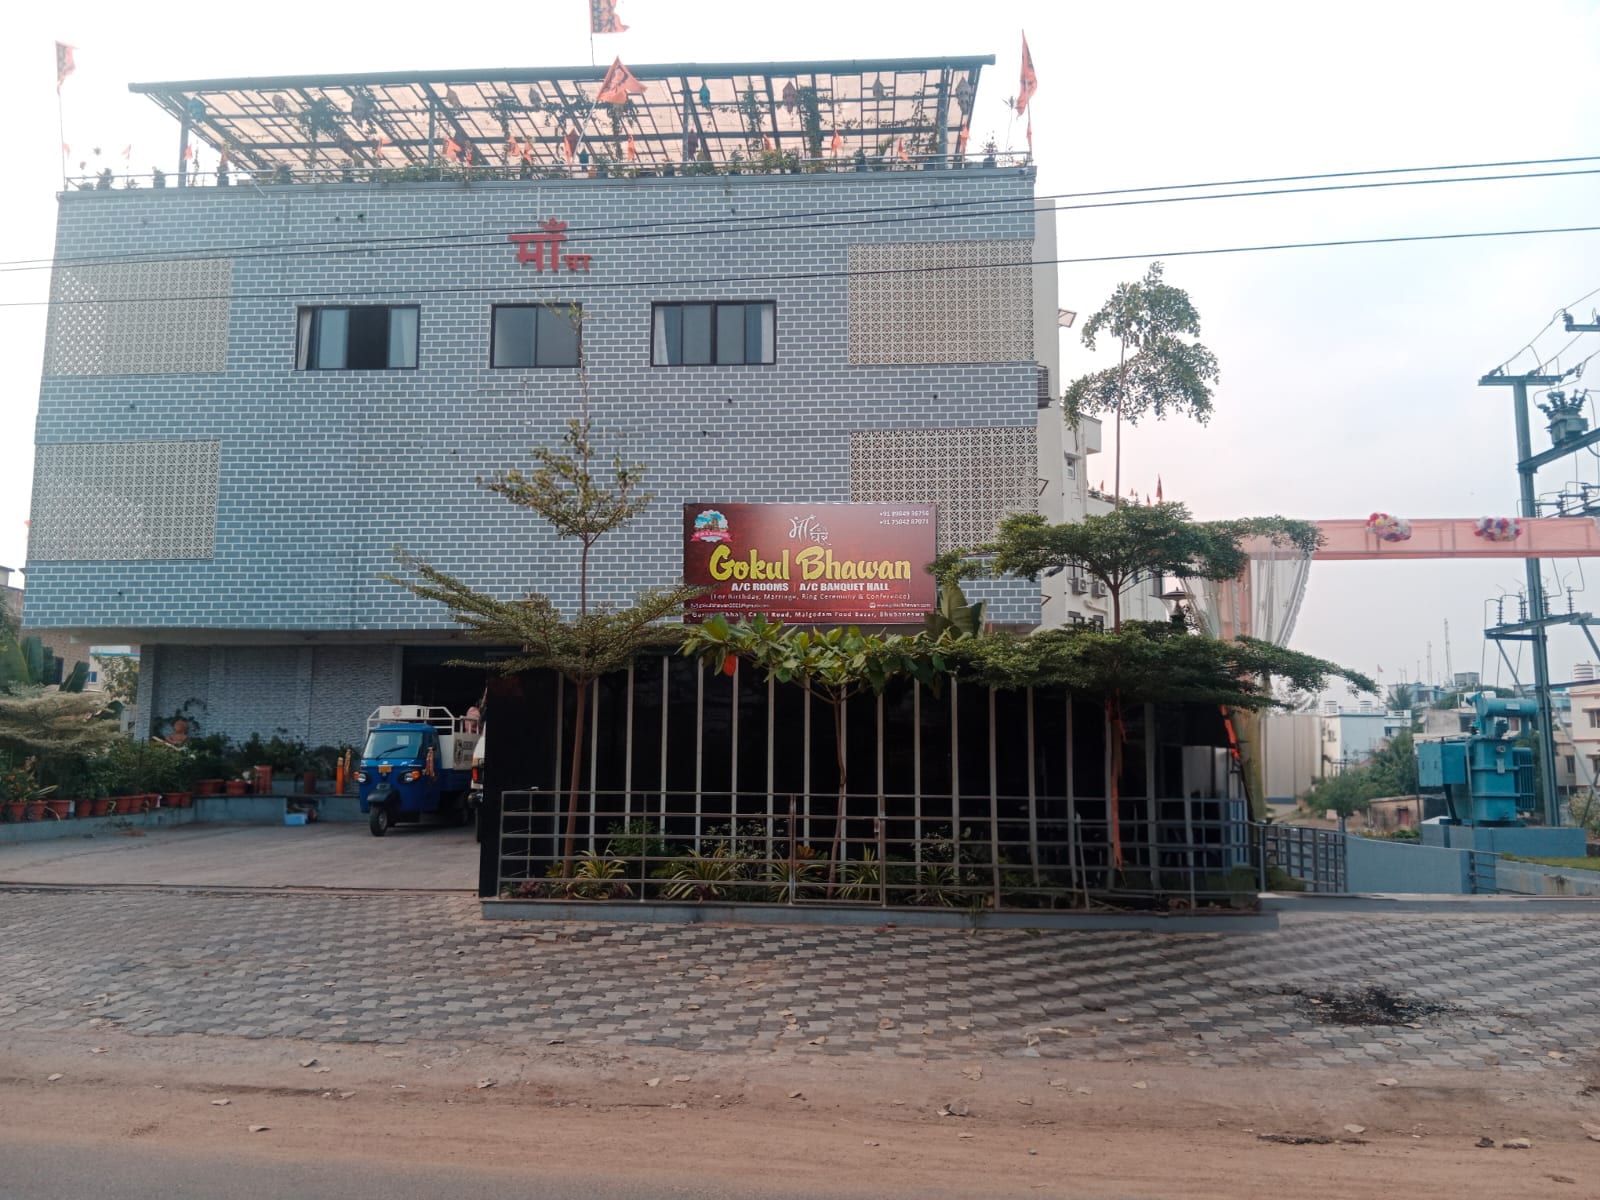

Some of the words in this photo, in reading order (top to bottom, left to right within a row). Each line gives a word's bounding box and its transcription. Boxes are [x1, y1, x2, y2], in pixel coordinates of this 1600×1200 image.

[708, 544, 790, 581] Gokul
[795, 546, 911, 580] Bhawan
[731, 583, 750, 591] A/C
[752, 583, 789, 591] ROOMS
[799, 583, 818, 591] A/C
[820, 583, 865, 591] BANQUET
[867, 583, 890, 591] HALL
[801, 593, 818, 601] Ring
[819, 593, 856, 601] Ceremony
